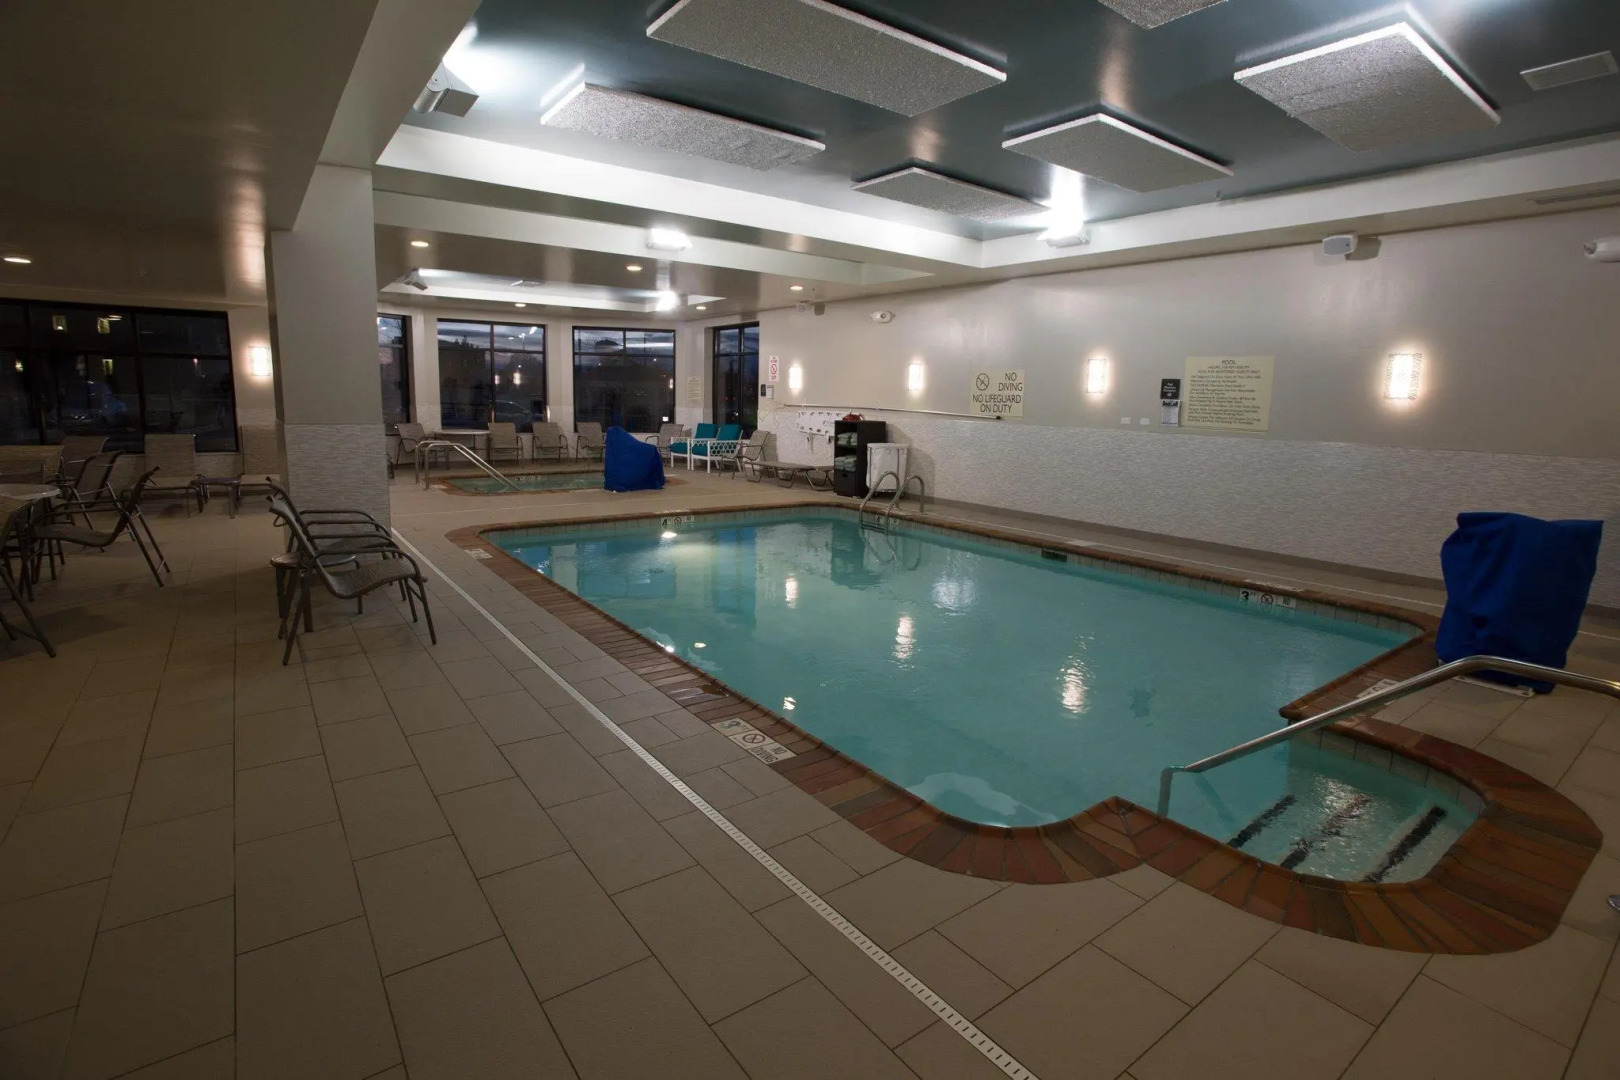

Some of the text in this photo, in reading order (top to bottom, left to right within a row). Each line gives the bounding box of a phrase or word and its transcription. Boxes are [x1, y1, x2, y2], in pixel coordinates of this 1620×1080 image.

[1005, 372, 1017, 381] NO
[998, 382, 1022, 391] DIVING
[972, 394, 1022, 404] NO LIFEGUARD
[980, 403, 1012, 413] ON DUTY
